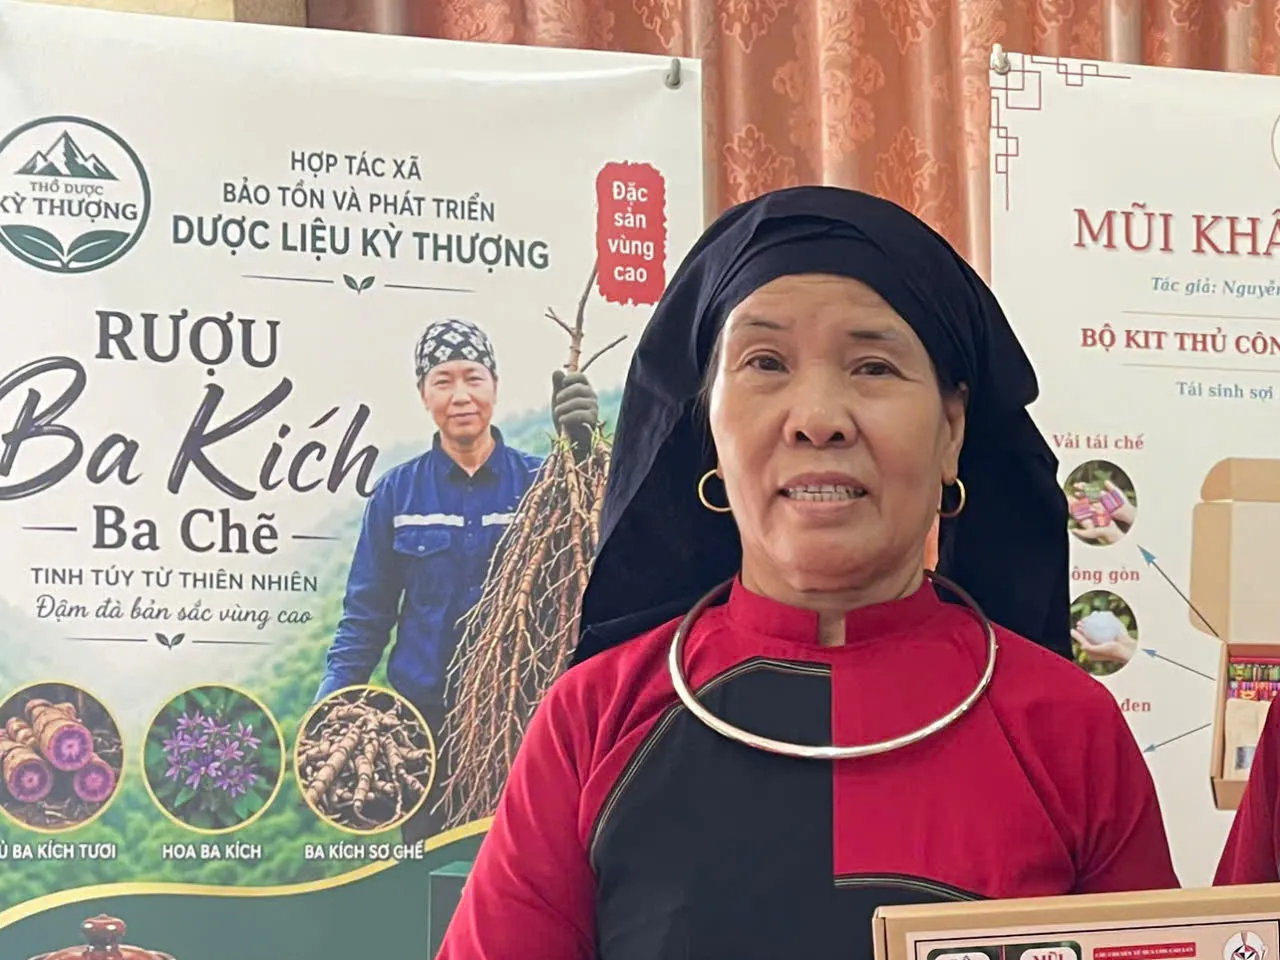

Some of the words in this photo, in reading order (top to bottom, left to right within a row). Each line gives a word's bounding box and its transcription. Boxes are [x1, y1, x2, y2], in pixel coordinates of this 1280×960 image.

[291, 151, 337, 178] HỢP
[344, 150, 385, 177] TÁC
[392, 155, 422, 181] XÃ
[64, 183, 104, 197] DƯỢC
[223, 176, 270, 205] BẢO
[277, 179, 324, 209] TỒN
[332, 186, 361, 212] VÀ
[369, 190, 425, 217] PHÁT
[432, 192, 495, 222] TRIỂN
[612, 180, 648, 206] Đặc
[33, 197, 138, 223] THƯỢNG
[614, 207, 647, 229] sản
[1073, 202, 1173, 252] MŨI
[173, 214, 270, 256] DƯỢC
[282, 217, 350, 261] LIỆU
[362, 222, 403, 259] KỲ
[412, 231, 549, 274] THƯỢNG
[608, 234, 654, 261] vùng
[614, 266, 648, 282] cao
[1150, 276, 1180, 292] Tác
[1185, 276, 1216, 296] giả:
[95, 309, 280, 376] RƯỢU
[1081, 322, 1116, 351] BỘ
[1124, 329, 1167, 351] KIT
[1174, 327, 1227, 353] THỦ
[1176, 381, 1202, 397] Tái
[1208, 383, 1244, 399] sinh
[1249, 384, 1273, 402] sợi
[0, 355, 141, 500] Ba
[167, 377, 382, 500] Kích
[1052, 432, 1080, 449] Vải
[1086, 434, 1108, 449] tái
[1114, 433, 1145, 450] chế
[93, 504, 160, 552] Ba
[180, 508, 279, 555] Chẽ
[31, 568, 83, 585] TINH
[90, 564, 135, 587] TÚY
[141, 566, 173, 588] TỪ
[179, 568, 243, 590] THIÊN
[251, 570, 318, 592] NHIÊN
[1071, 565, 1102, 585] ông
[1108, 566, 1140, 585] gòn
[36, 593, 89, 624] Đậm
[95, 596, 124, 619] đà
[130, 595, 172, 621] bản
[177, 599, 213, 622] sắc
[219, 602, 271, 631] vùng
[277, 608, 314, 625] cao
[12, 844, 34, 859] BA
[37, 840, 74, 859] KÍCH
[79, 843, 116, 859] TƯƠI
[162, 844, 196, 859] HOA
[200, 844, 221, 859] BA
[225, 840, 262, 859] KÍCH
[304, 844, 325, 859] BA
[329, 840, 365, 859] KÍCH
[368, 843, 390, 859] SƠ
